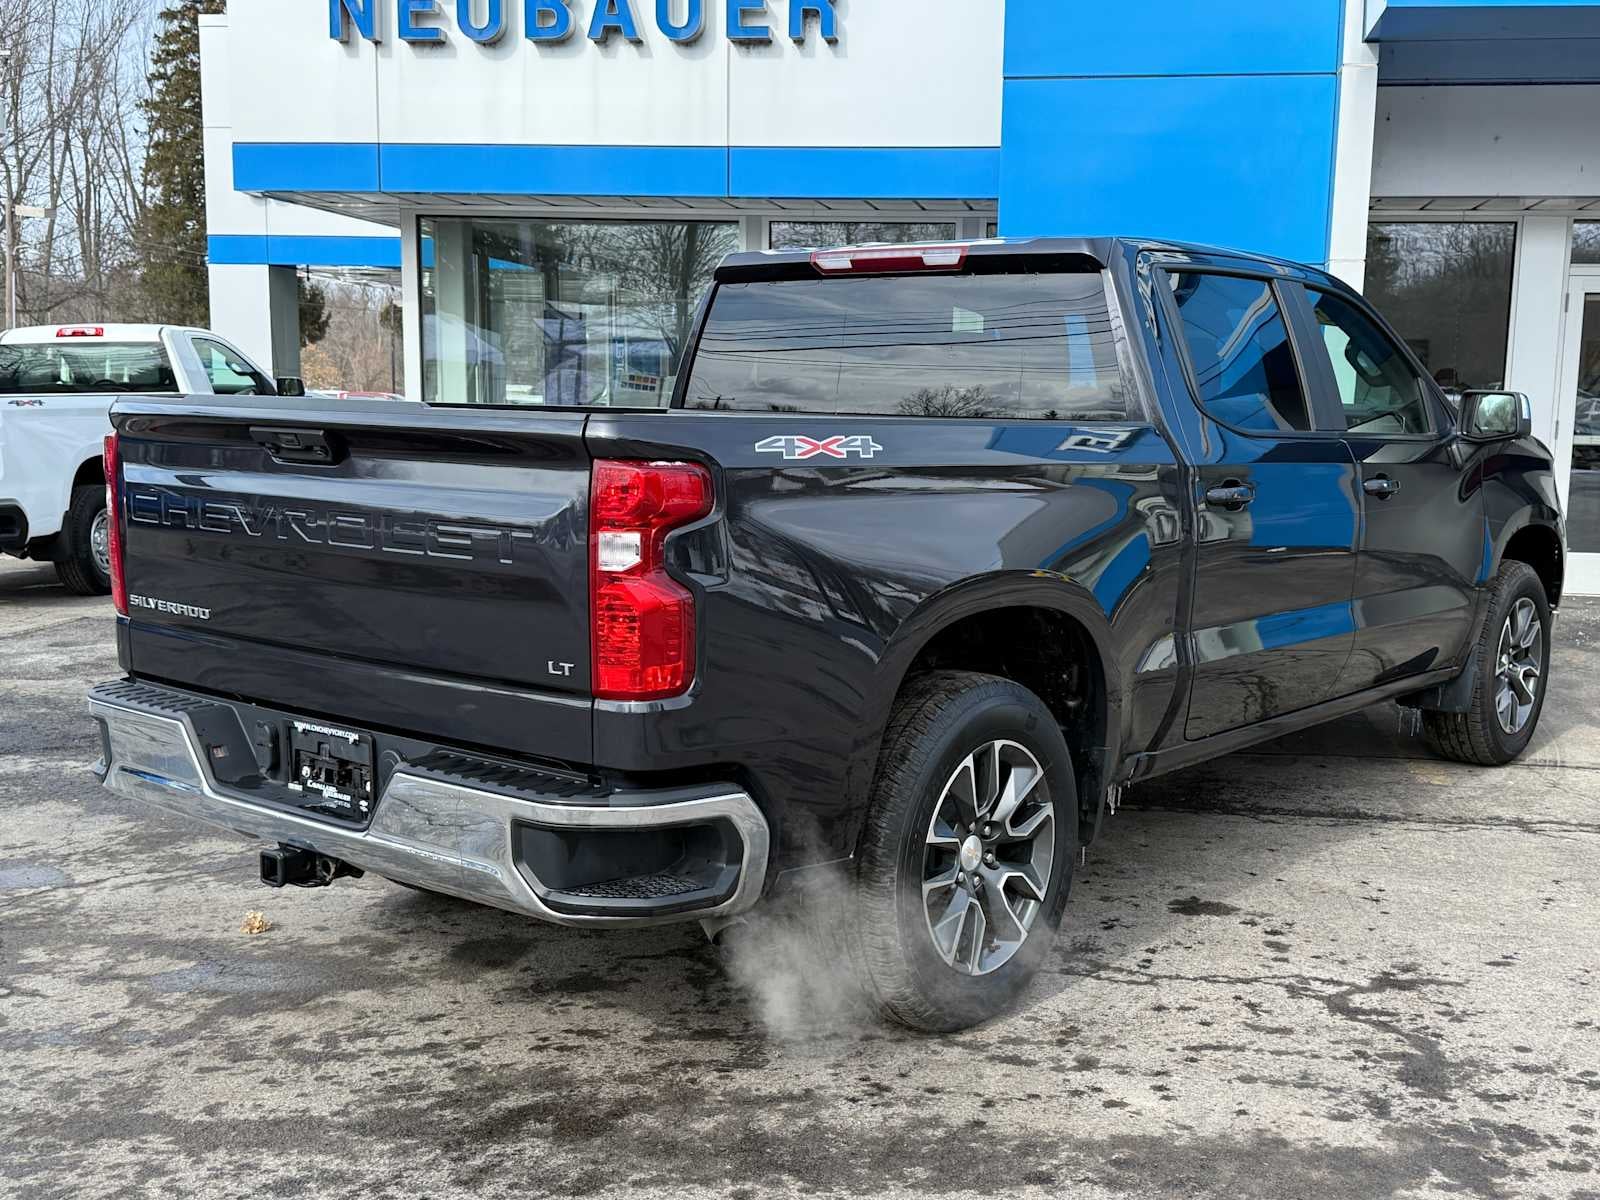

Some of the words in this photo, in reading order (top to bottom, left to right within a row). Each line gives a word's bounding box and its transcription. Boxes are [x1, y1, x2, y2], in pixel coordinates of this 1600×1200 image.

[329, 0, 838, 43] NEUBAUER
[130, 490, 537, 564] CHEVROLET
[129, 594, 211, 620] SILVERADO
[547, 660, 574, 676] LT
